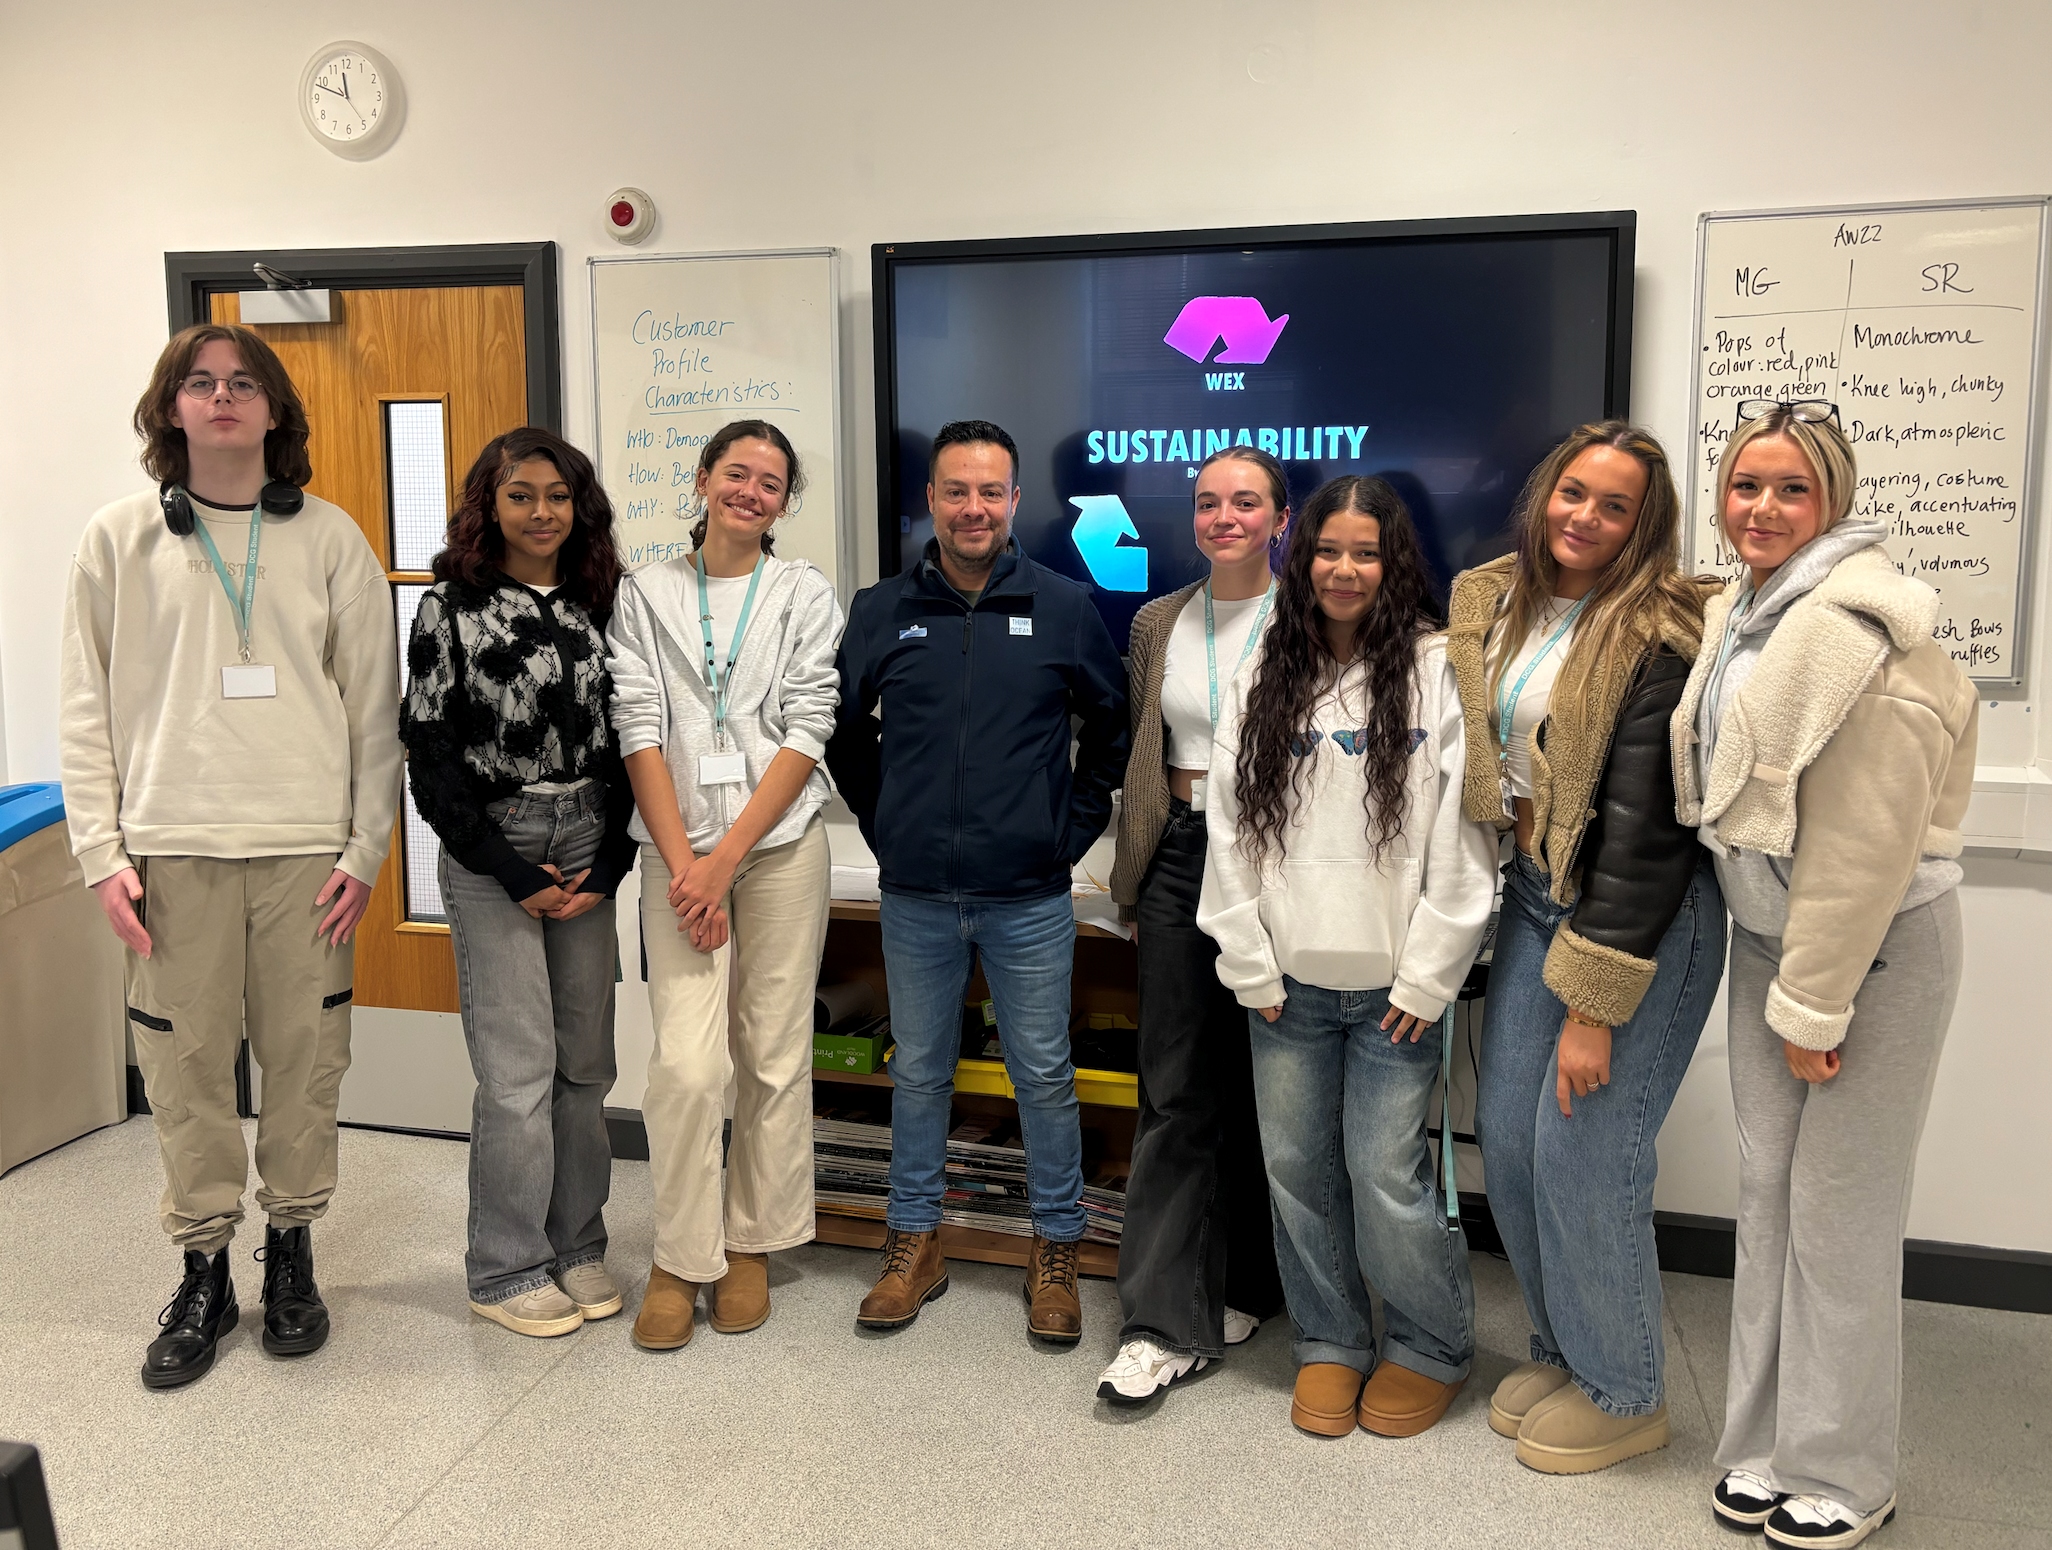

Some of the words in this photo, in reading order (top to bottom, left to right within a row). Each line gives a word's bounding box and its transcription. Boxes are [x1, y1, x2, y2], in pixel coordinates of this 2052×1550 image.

[328, 64, 338, 75] 11
[341, 58, 352, 70] 12
[318, 76, 329, 87] 10
[371, 73, 377, 84] 2
[314, 93, 320, 104] 9
[376, 90, 382, 102] 3
[320, 109, 326, 120] 8
[371, 108, 377, 118] 4
[332, 120, 338, 131] 7
[346, 124, 352, 135] 6
[361, 119, 367, 131] 5
[1834, 222, 1883, 248] AW22
[1735, 266, 1781, 297] MG
[1921, 262, 1975, 293] SR
[632, 309, 736, 345] Customer
[1854, 323, 1985, 350] Monochrome
[1715, 330, 1753, 357] Pops
[1765, 327, 1787, 355] of
[652, 348, 714, 379] Profile
[1205, 371, 1245, 391] WEX
[1850, 373, 1890, 398] Knee
[1086, 425, 1370, 465] SUSTAINABILITY
[1855, 472, 1930, 500] ayering,
[1936, 469, 2010, 489] costume
[1909, 496, 2017, 523] accentuating
[250, 524, 259, 548] Student
[1891, 519, 1971, 537] ilhouette
[249, 548, 257, 564] DCG
[246, 575, 254, 601] Student
[1011, 618, 1030, 626] THINK
[1932, 618, 1965, 641] esh
[1970, 618, 2003, 638] Bows
[1521, 663, 1535, 680] DCG
[1533, 640, 1554, 666] Student
[1505, 691, 1519, 719] Student
[1502, 719, 1511, 733] DCG
